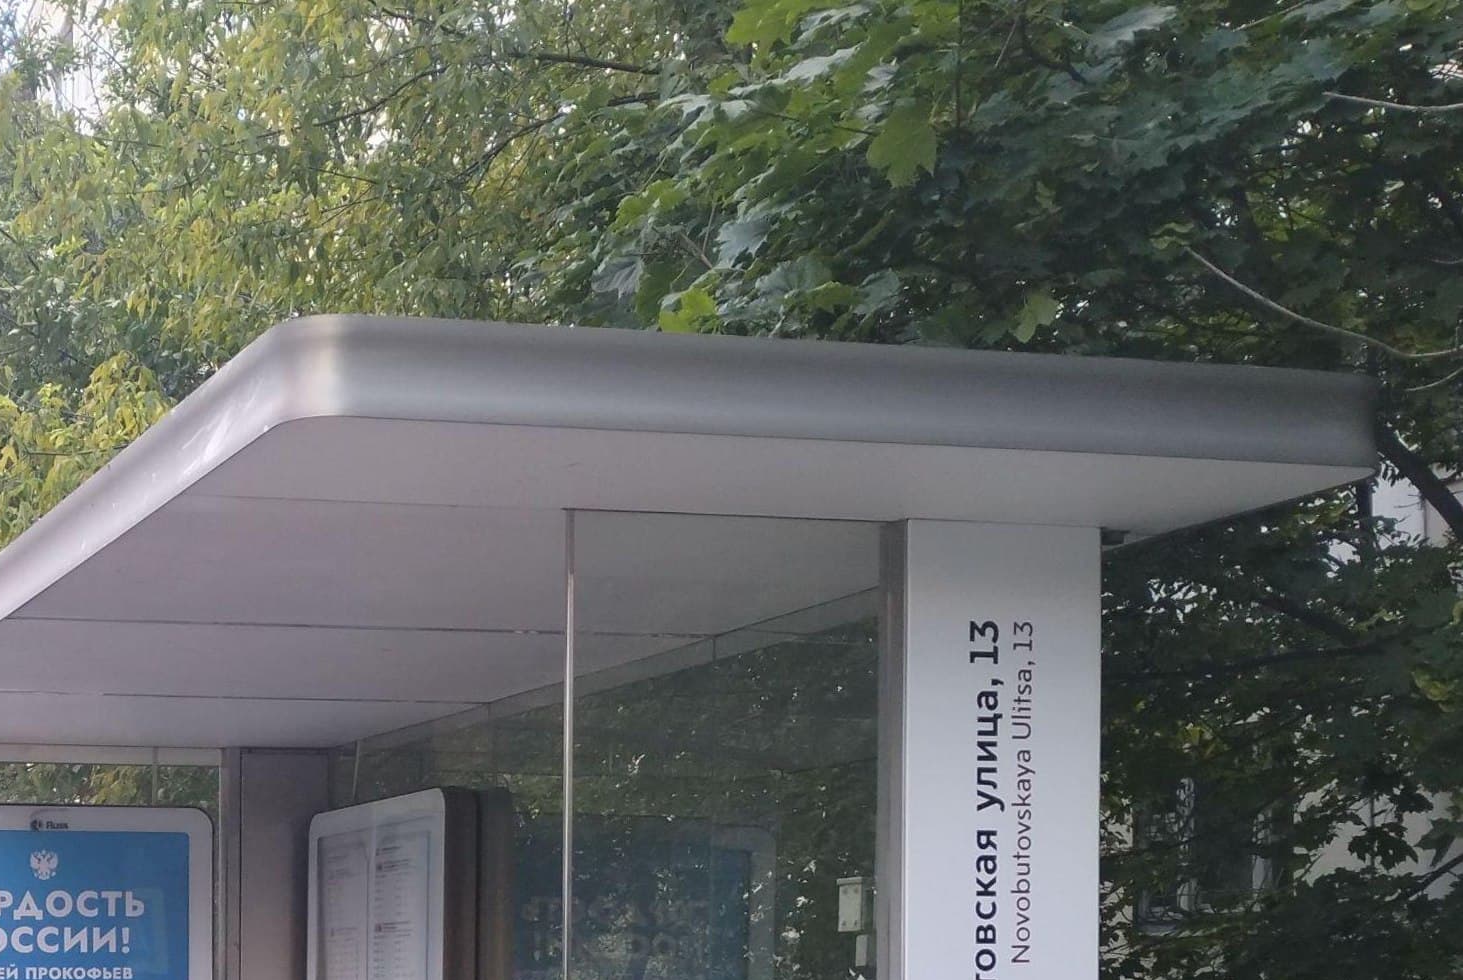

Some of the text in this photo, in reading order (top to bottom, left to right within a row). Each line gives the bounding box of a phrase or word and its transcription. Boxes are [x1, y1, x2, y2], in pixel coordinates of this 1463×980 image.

[968, 620, 1000, 665] 13
[976, 678, 1006, 813] улица,
[1010, 620, 1036, 964] Novobutovskaya Ulitsa, 13
[25, 966, 133, 980] ПРОКОФЬЕВ
